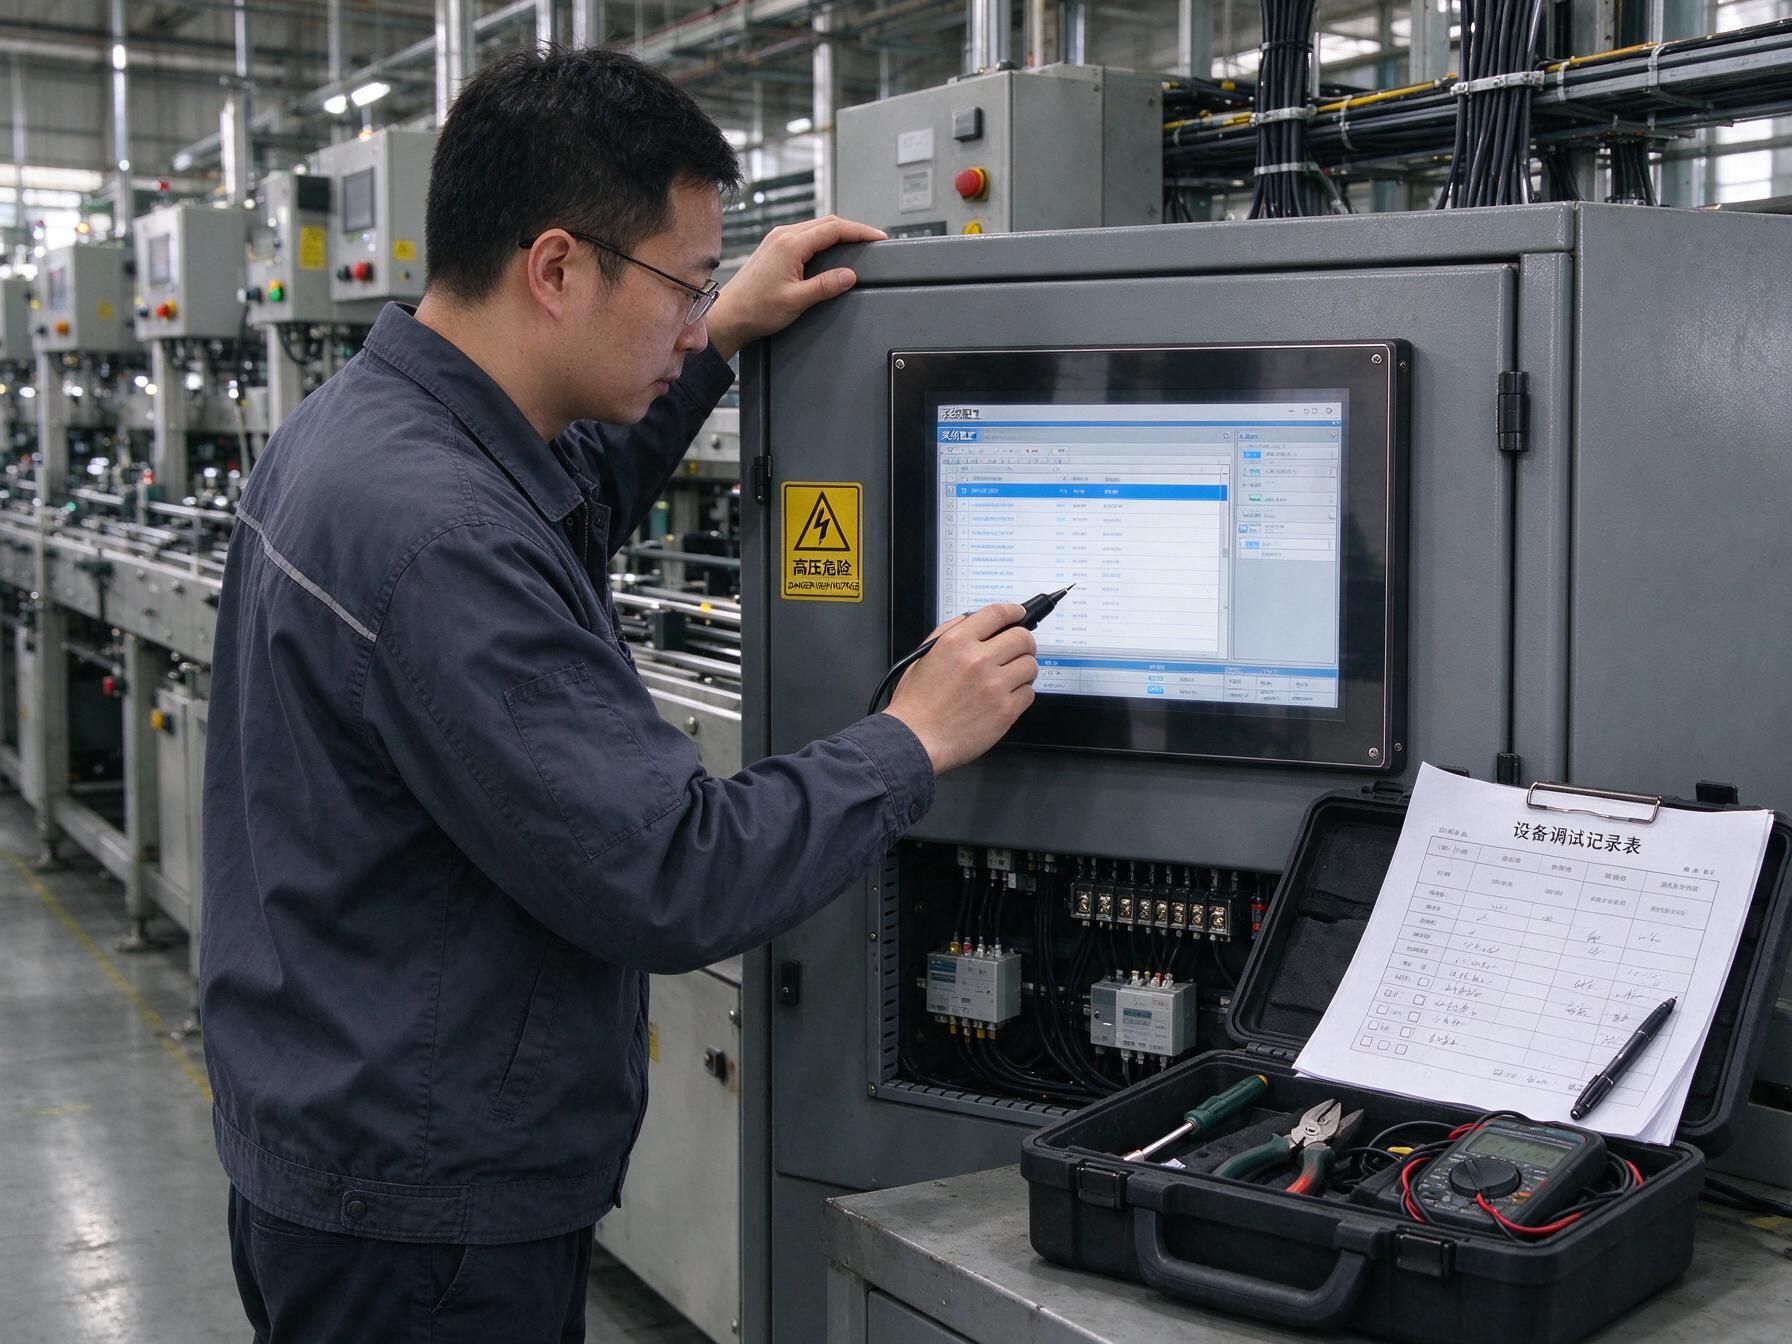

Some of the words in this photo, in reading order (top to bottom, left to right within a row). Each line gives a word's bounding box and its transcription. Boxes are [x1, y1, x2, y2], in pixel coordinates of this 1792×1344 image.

[793, 558, 852, 576] 高压危险
[1513, 821, 1642, 855] 设备调试记录表
